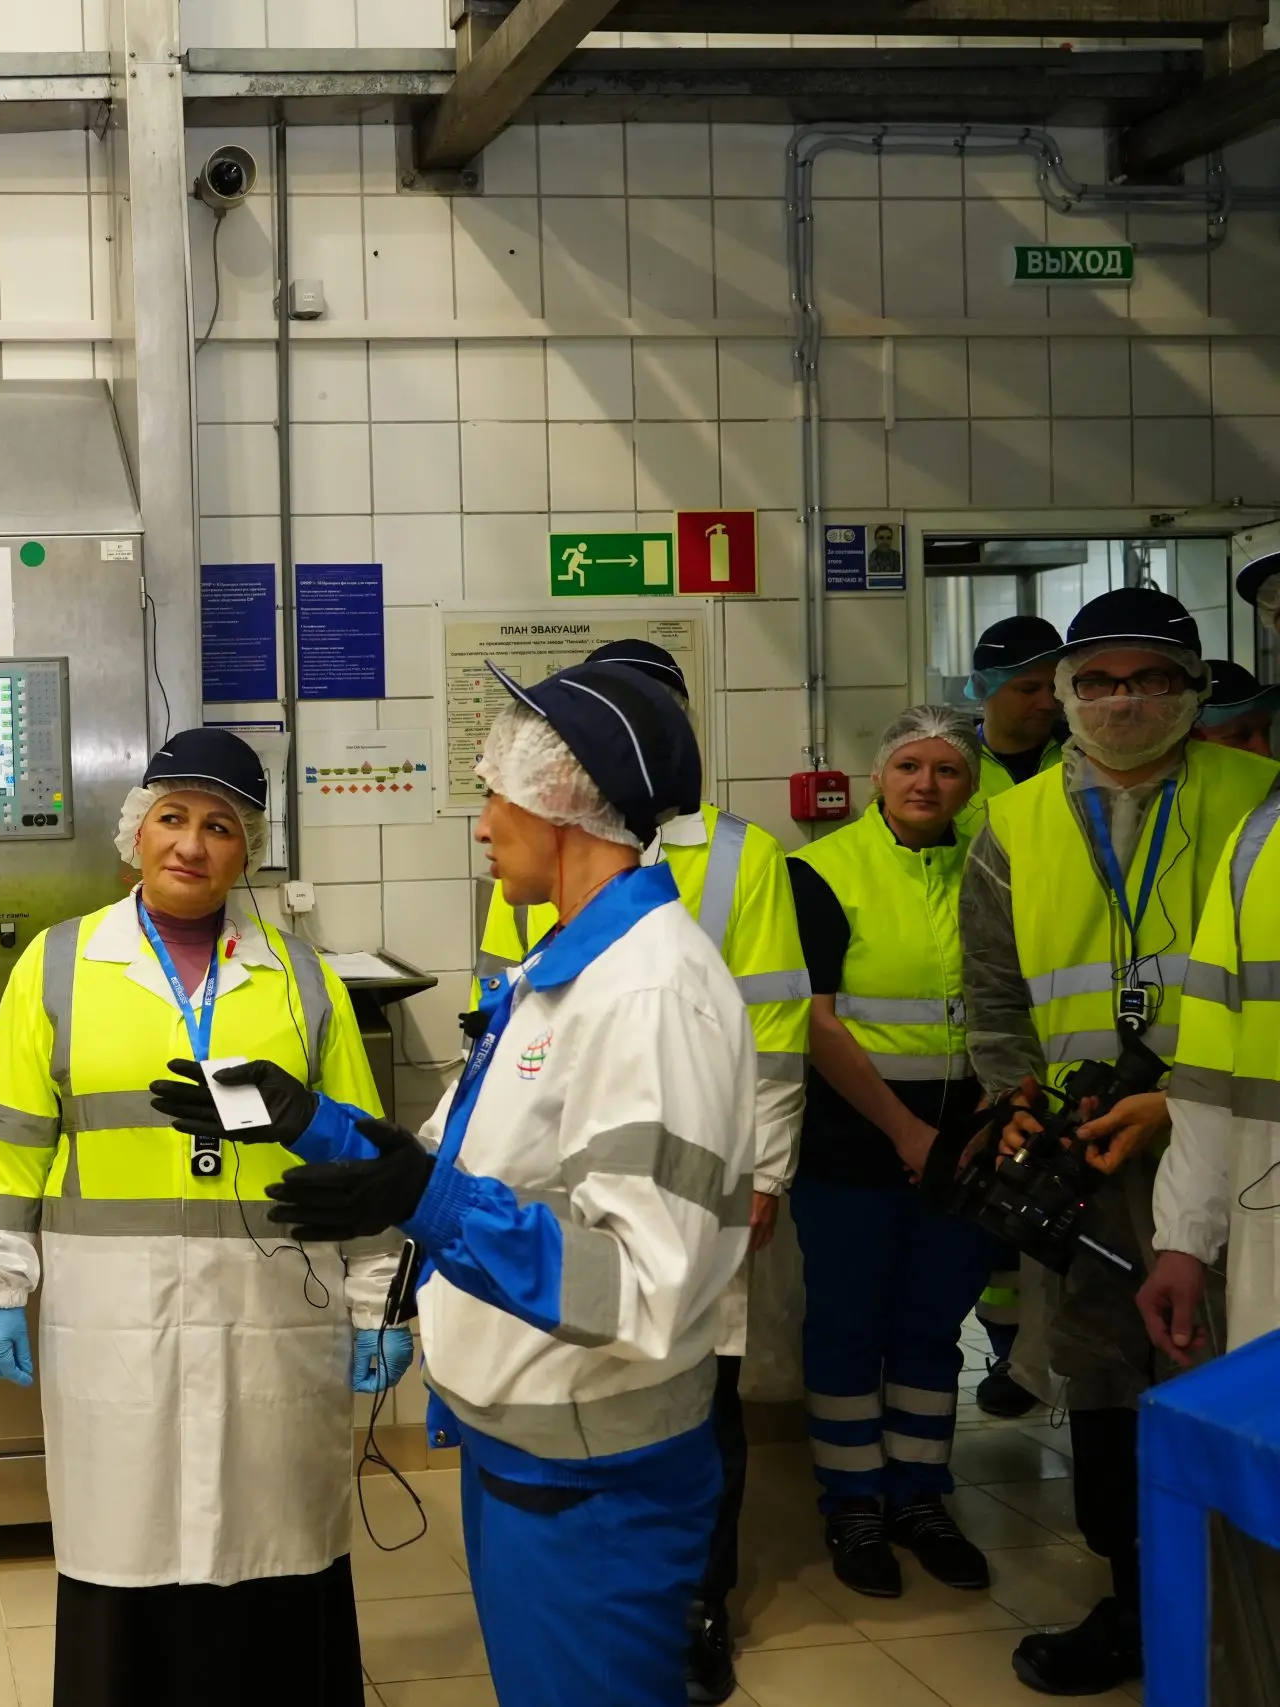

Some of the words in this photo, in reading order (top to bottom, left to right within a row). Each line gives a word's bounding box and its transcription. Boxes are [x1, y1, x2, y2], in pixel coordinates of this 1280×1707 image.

[1027, 250, 1123, 275] ВЫХОД
[501, 626, 528, 635] ПЛАН
[530, 625, 590, 635] ЭВАКУАЦИИ
[467, 1032, 496, 1079] RETEKE
